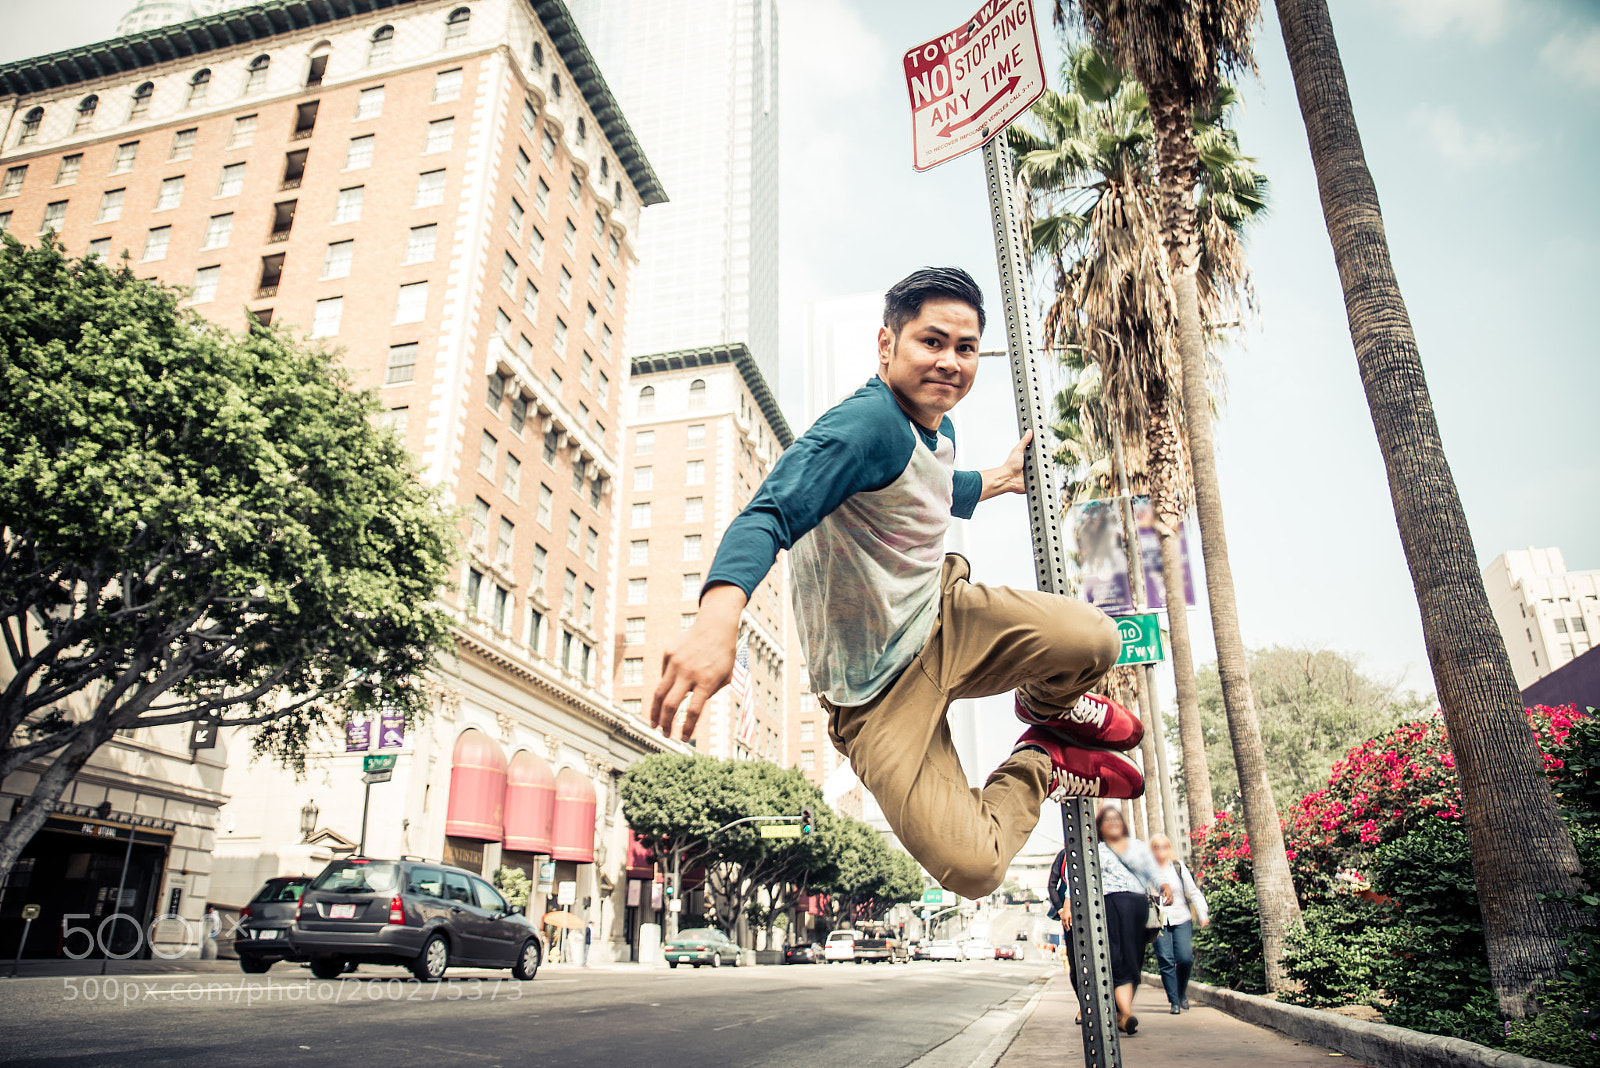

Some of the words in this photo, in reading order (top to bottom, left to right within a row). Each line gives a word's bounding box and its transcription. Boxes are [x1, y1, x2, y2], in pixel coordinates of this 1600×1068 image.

[911, 64, 950, 108] NO
[954, 1, 1027, 81] STOPPING
[931, 88, 971, 128] ANY
[981, 43, 1024, 93] TIME
[1126, 644, 1156, 660] Fwy
